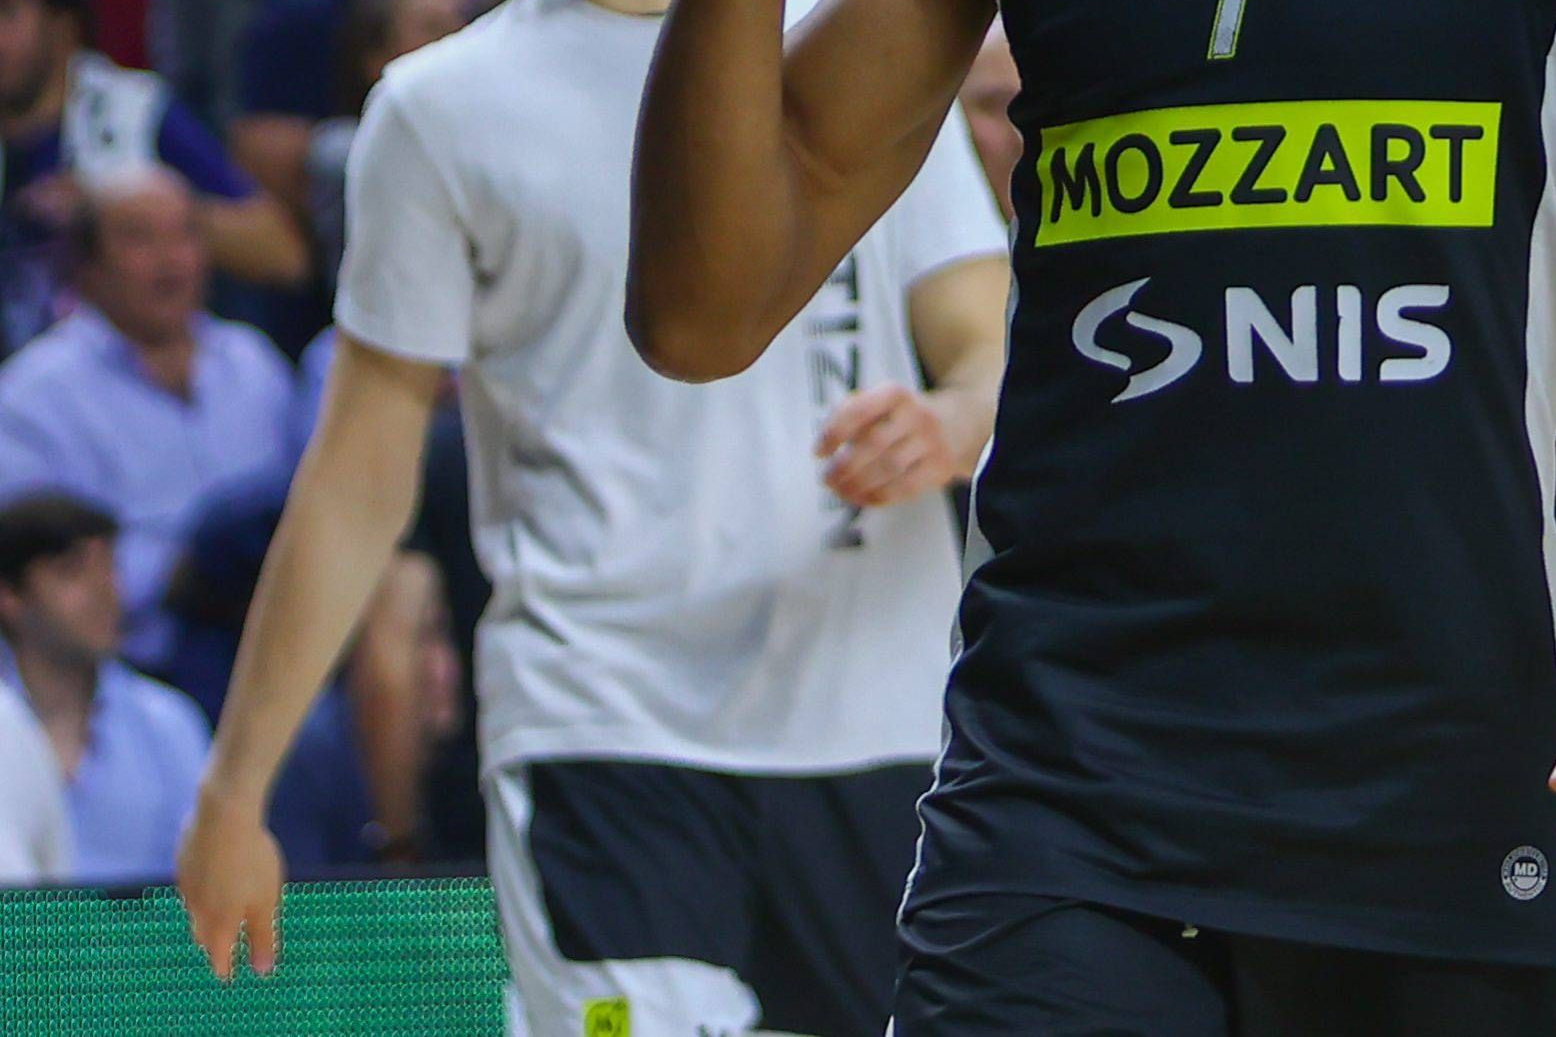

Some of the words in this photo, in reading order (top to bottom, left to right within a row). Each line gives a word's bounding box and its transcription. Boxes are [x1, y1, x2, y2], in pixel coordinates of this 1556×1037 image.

[1050, 123, 1483, 223] MOZZART
[1225, 284, 1451, 383] NIS
[1514, 862, 1538, 876] MD
